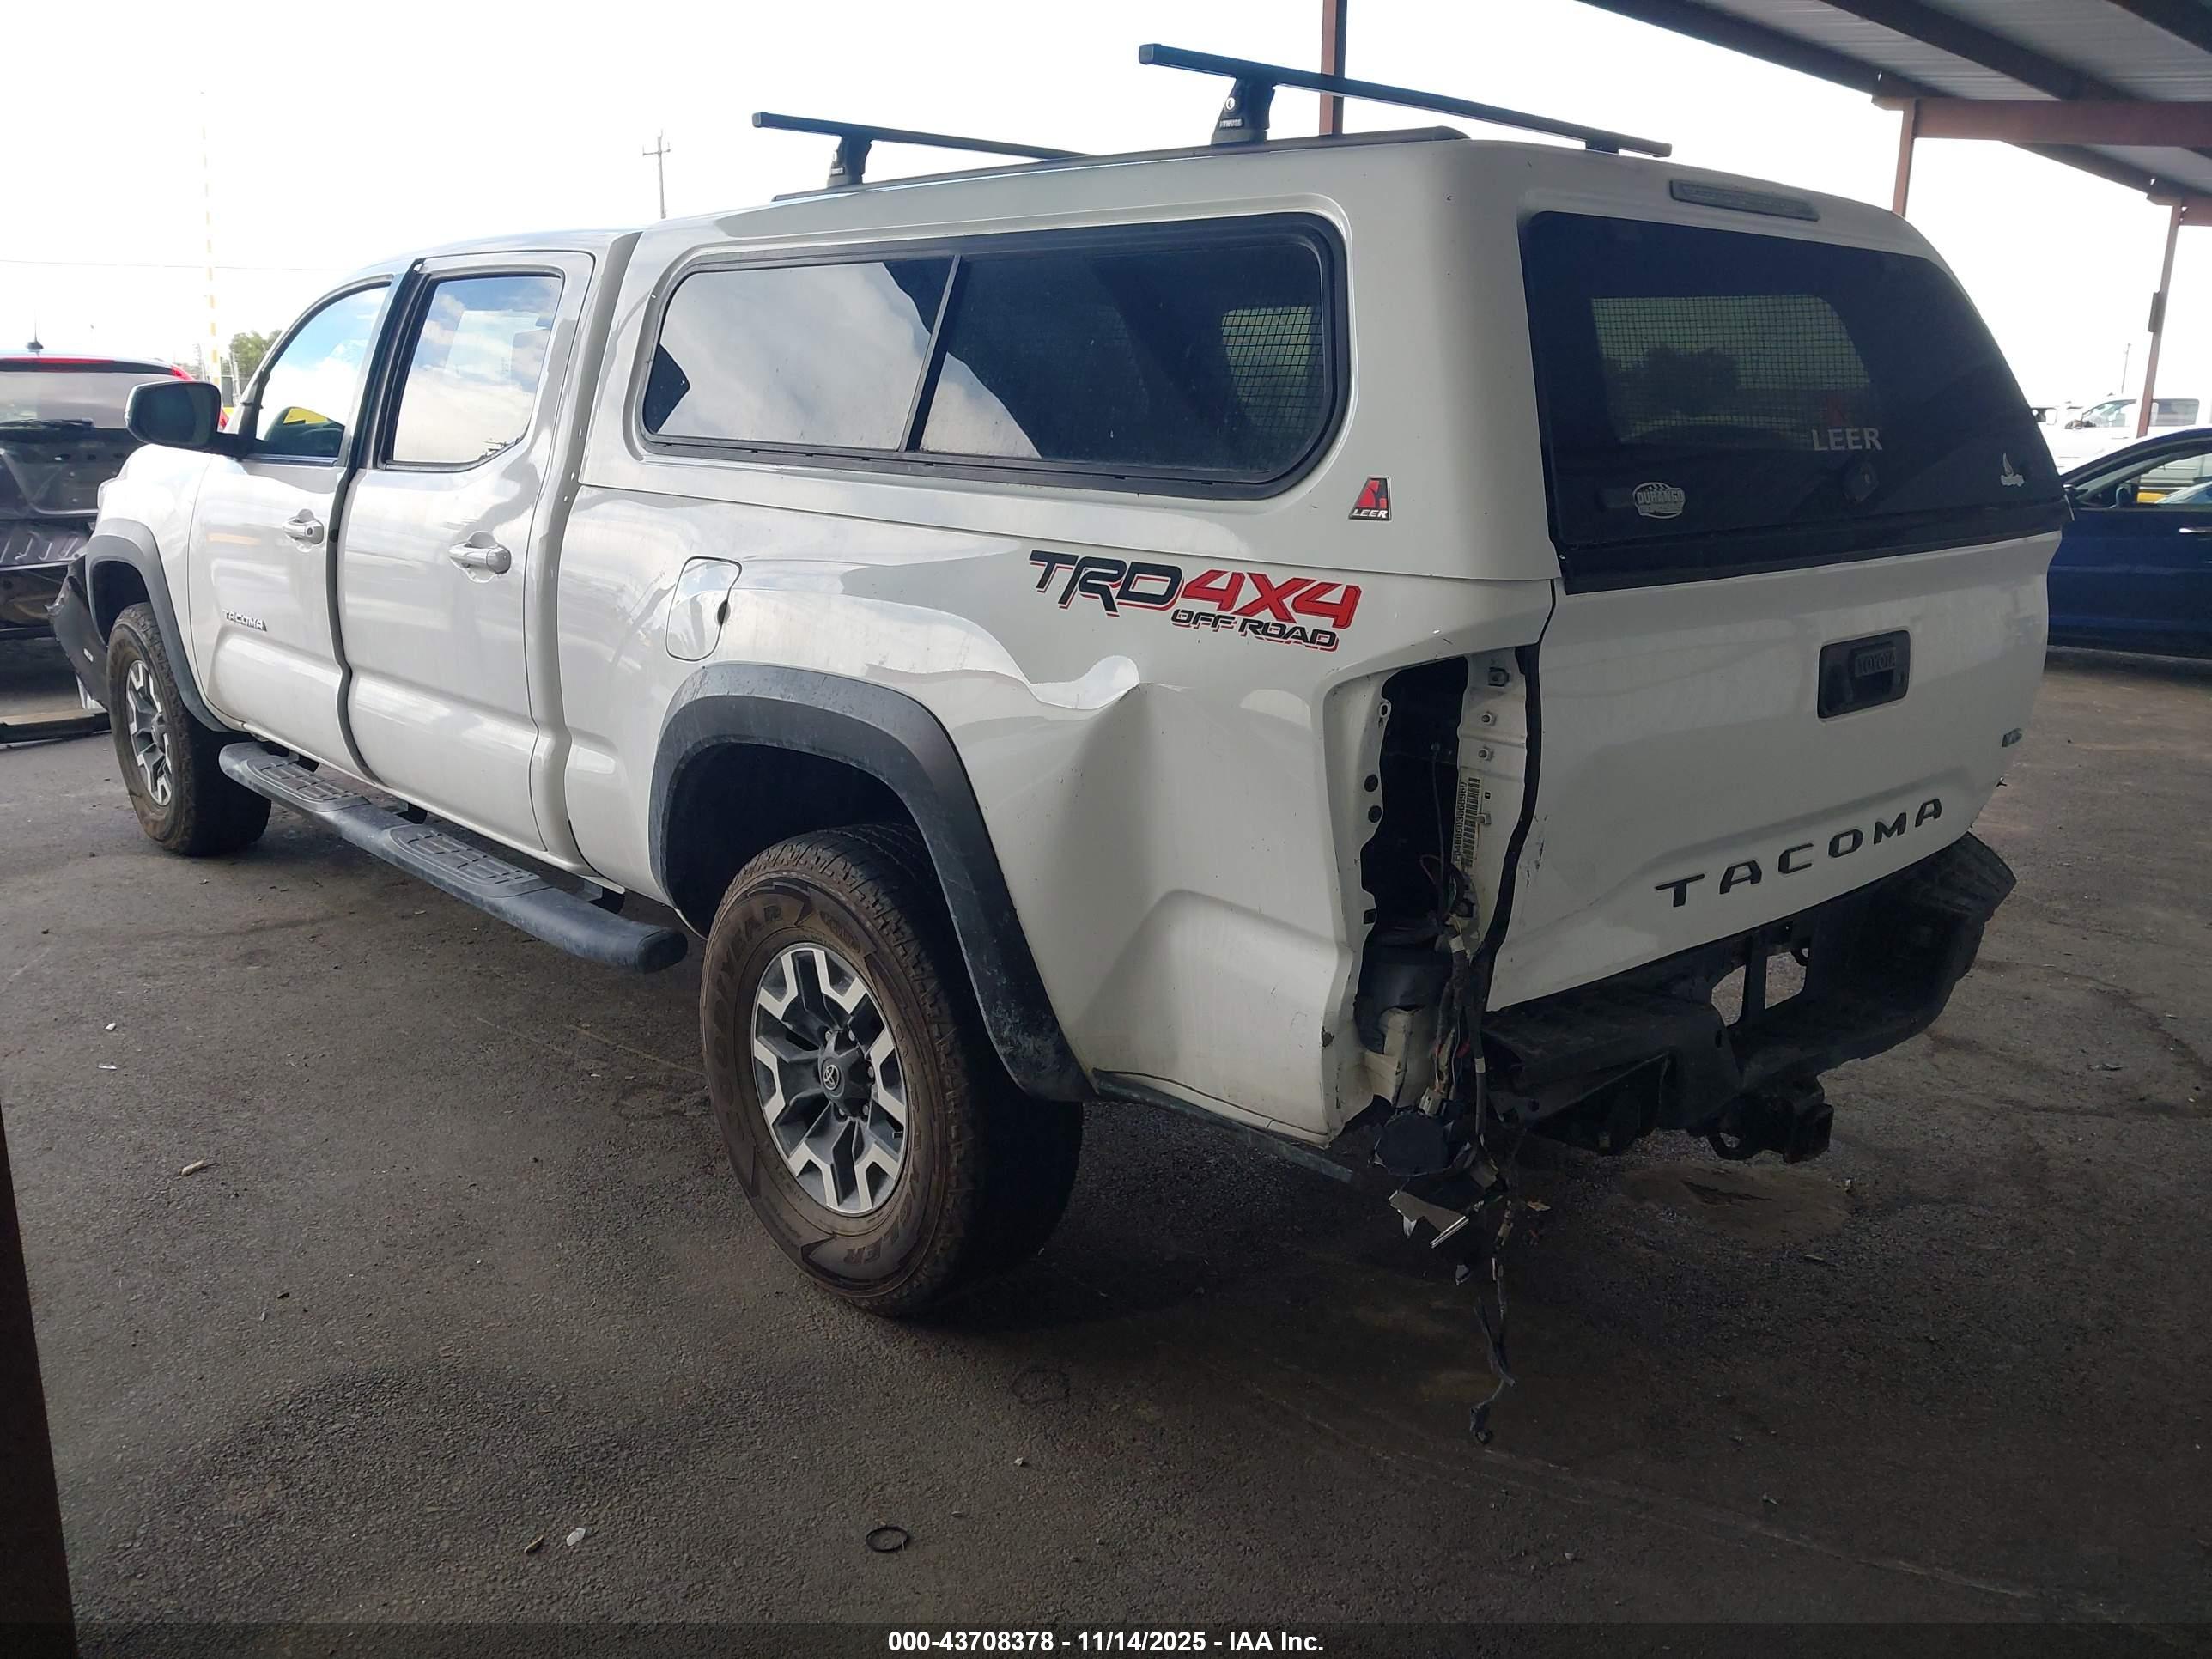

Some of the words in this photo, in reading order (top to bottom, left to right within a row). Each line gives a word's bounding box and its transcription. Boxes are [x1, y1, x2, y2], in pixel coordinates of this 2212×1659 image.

[1812, 428, 1883, 452] LEER
[1352, 507, 1389, 519] LEER
[1029, 550, 1185, 617] TRD
[222, 609, 267, 632] TACOMA
[1170, 607, 1236, 632] OFF
[1237, 617, 1340, 652] ROAD
[1654, 798, 1942, 908] TACOMA
